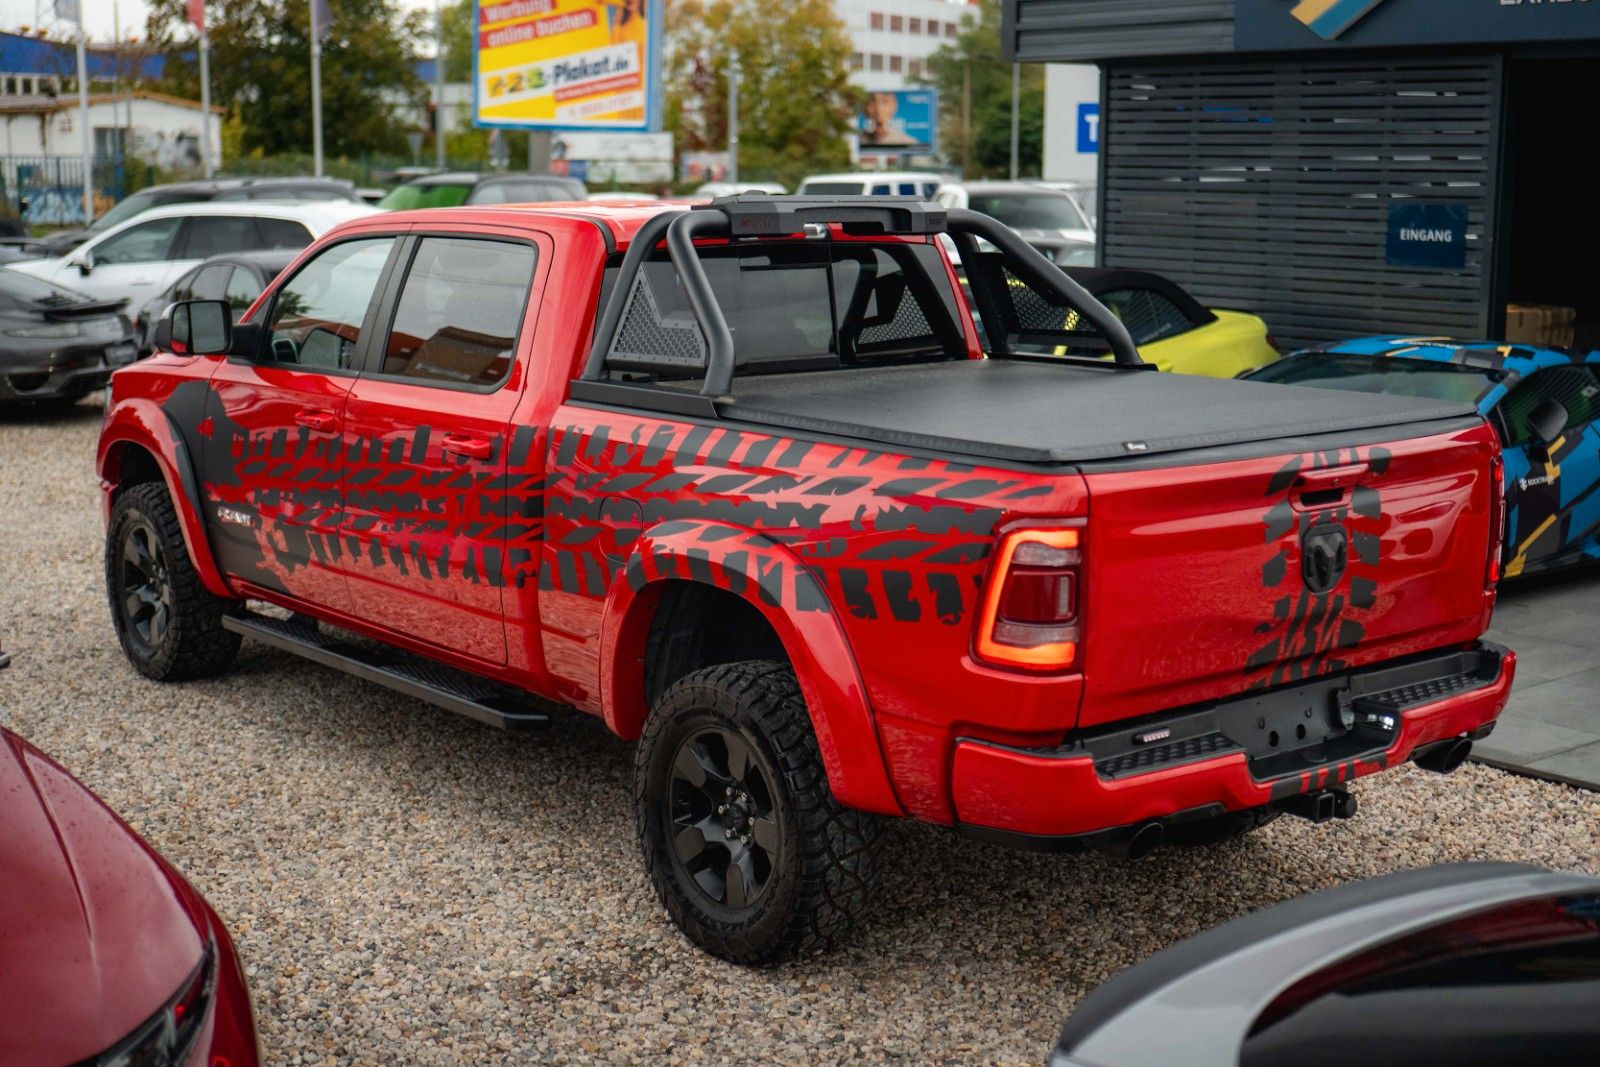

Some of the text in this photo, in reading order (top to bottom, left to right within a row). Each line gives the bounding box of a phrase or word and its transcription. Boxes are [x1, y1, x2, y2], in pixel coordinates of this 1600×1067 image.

[487, 12, 594, 48] online buchen
[1400, 227, 1452, 242] EINGANG
